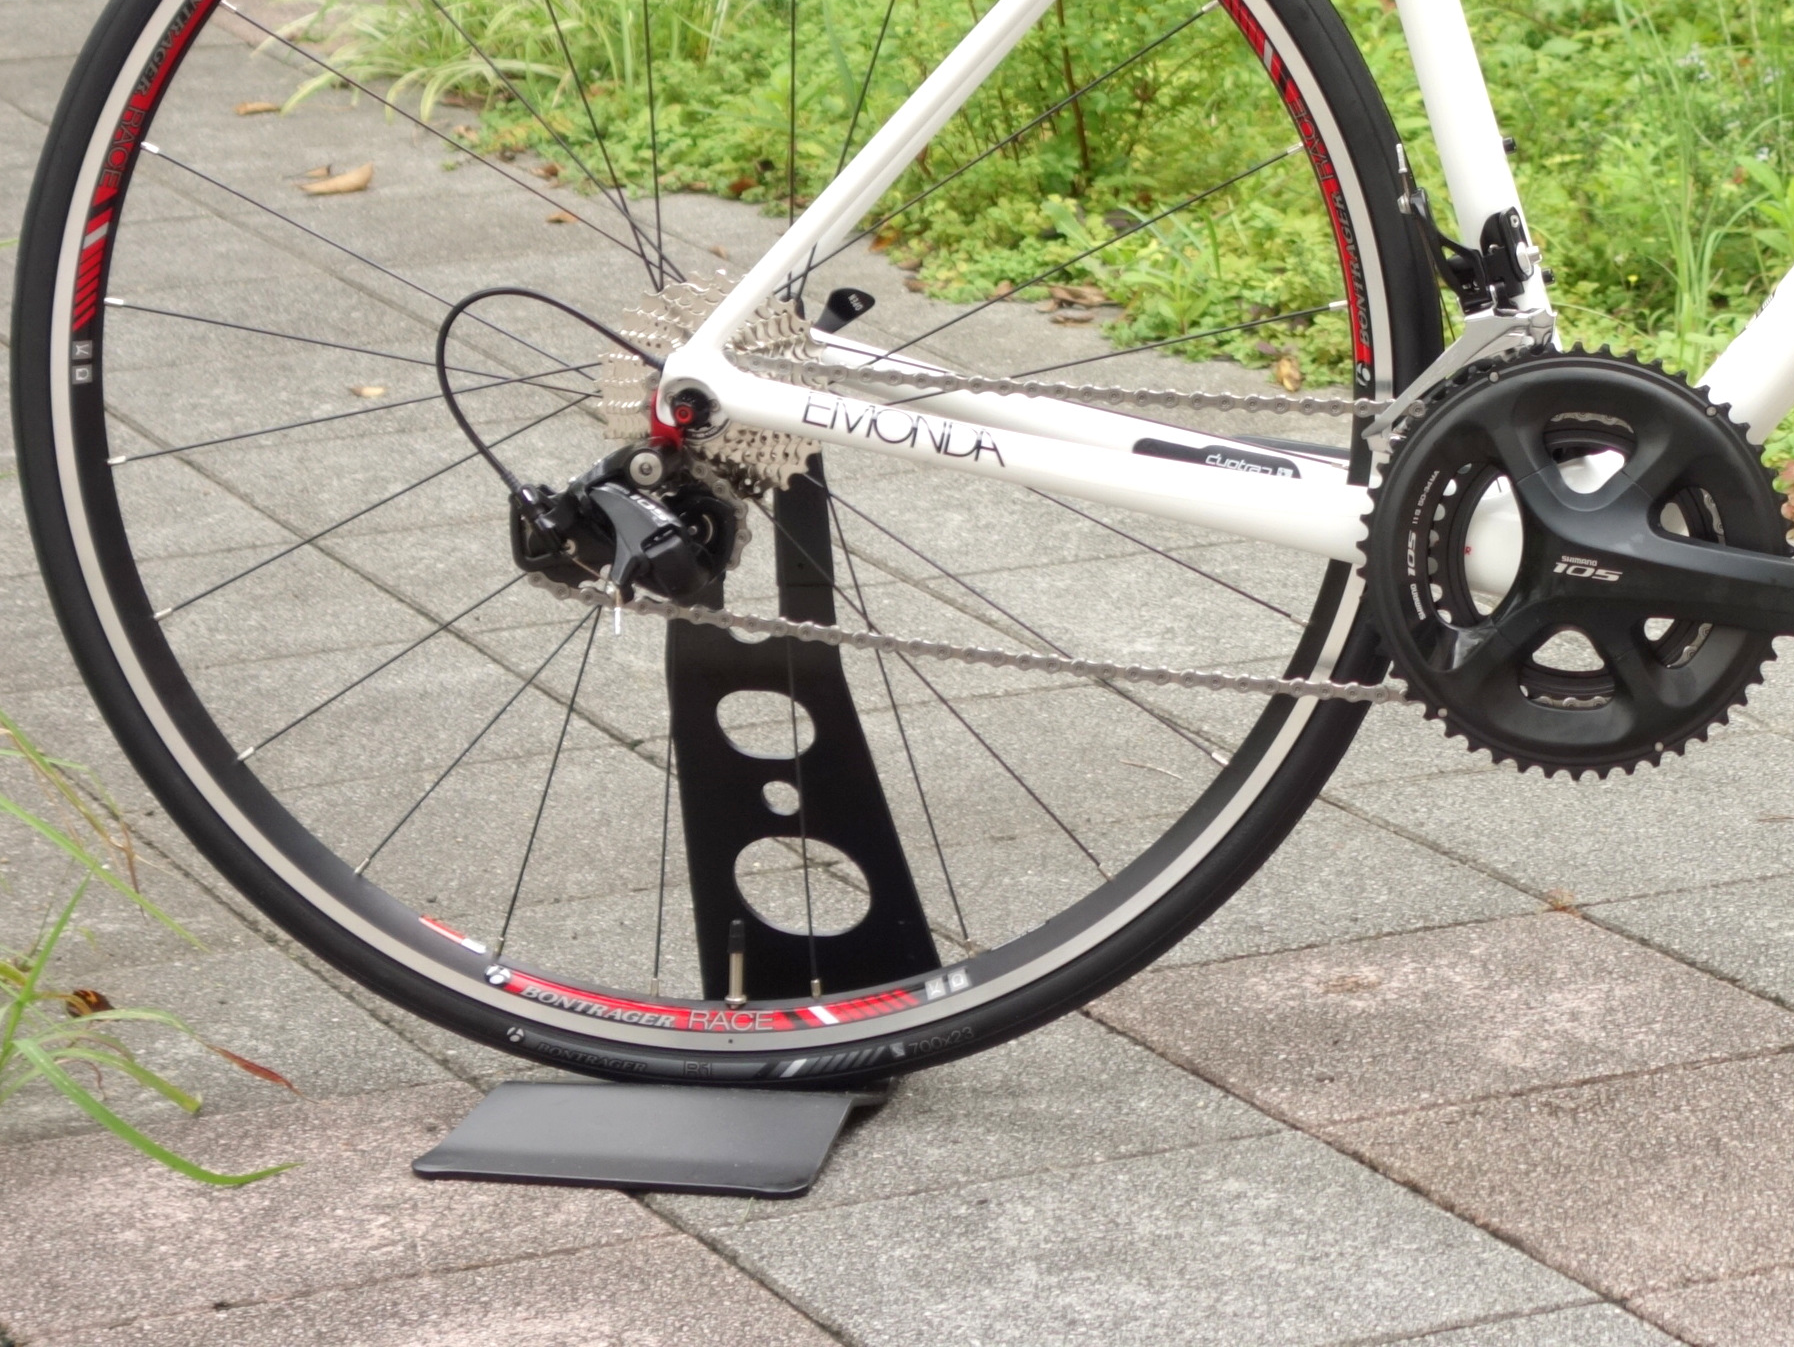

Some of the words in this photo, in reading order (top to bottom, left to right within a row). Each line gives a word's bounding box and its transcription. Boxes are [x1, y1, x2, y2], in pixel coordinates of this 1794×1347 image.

[99, 105, 145, 189] RACE
[1289, 97, 1338, 183] RACE
[1333, 190, 1372, 348] BONTRAGER
[1407, 530, 1417, 577] 105
[1553, 562, 1623, 582] 105
[1561, 555, 1598, 567] SHIMANO
[1410, 583, 1426, 620] SHIMANO
[521, 984, 676, 1028] BONTRAGER
[687, 1009, 776, 1031] RACE
[537, 1040, 648, 1073] BONTRAGER
[908, 1026, 975, 1056] 700x23
